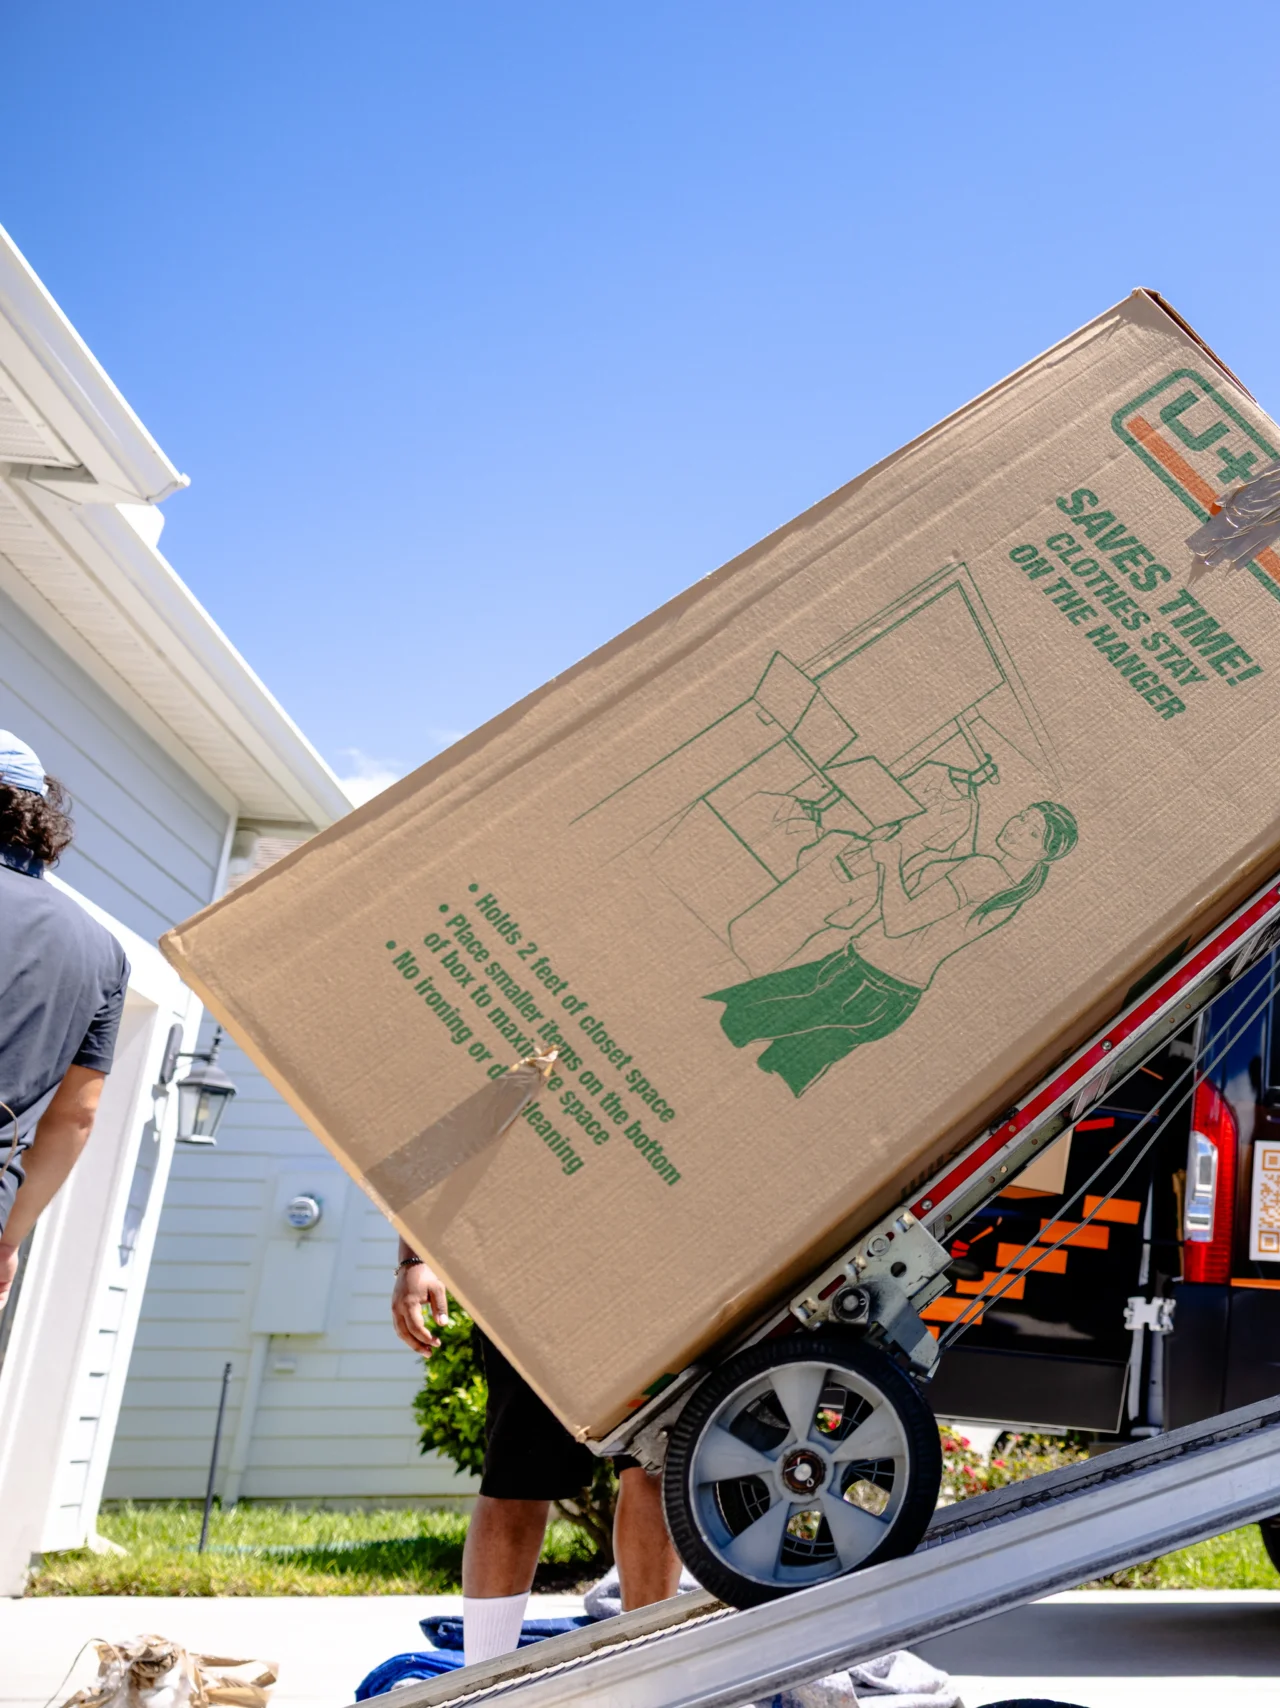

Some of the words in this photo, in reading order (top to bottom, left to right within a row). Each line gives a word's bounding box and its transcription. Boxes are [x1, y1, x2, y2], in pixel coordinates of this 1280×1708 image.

[1009, 544, 1055, 580] ON
[1042, 576, 1099, 626] THE
[1084, 623, 1186, 721] HANGER
[1045, 532, 1151, 631] CLOTHES
[1141, 631, 1208, 686] STAY
[1056, 488, 1172, 592] SAVES
[1157, 587, 1264, 687] TIME!
[392, 950, 420, 981] No
[414, 976, 474, 1046] ironing
[468, 1041, 493, 1064] or
[522, 1102, 585, 1176] leaning
[423, 933, 452, 954] of
[440, 952, 477, 989] box
[470, 983, 493, 1009] to
[558, 1090, 610, 1146] space
[445, 913, 490, 963] Place
[484, 961, 545, 1023] smaller
[537, 1020, 583, 1072] items
[578, 1070, 605, 1097] on
[600, 1093, 630, 1125] the
[623, 1120, 682, 1187] bottom
[474, 893, 523, 946] Holds
[516, 941, 539, 961] 2
[530, 957, 569, 997] feet
[560, 994, 588, 1017] of
[578, 1013, 633, 1071] closet
[625, 1068, 676, 1123] space
